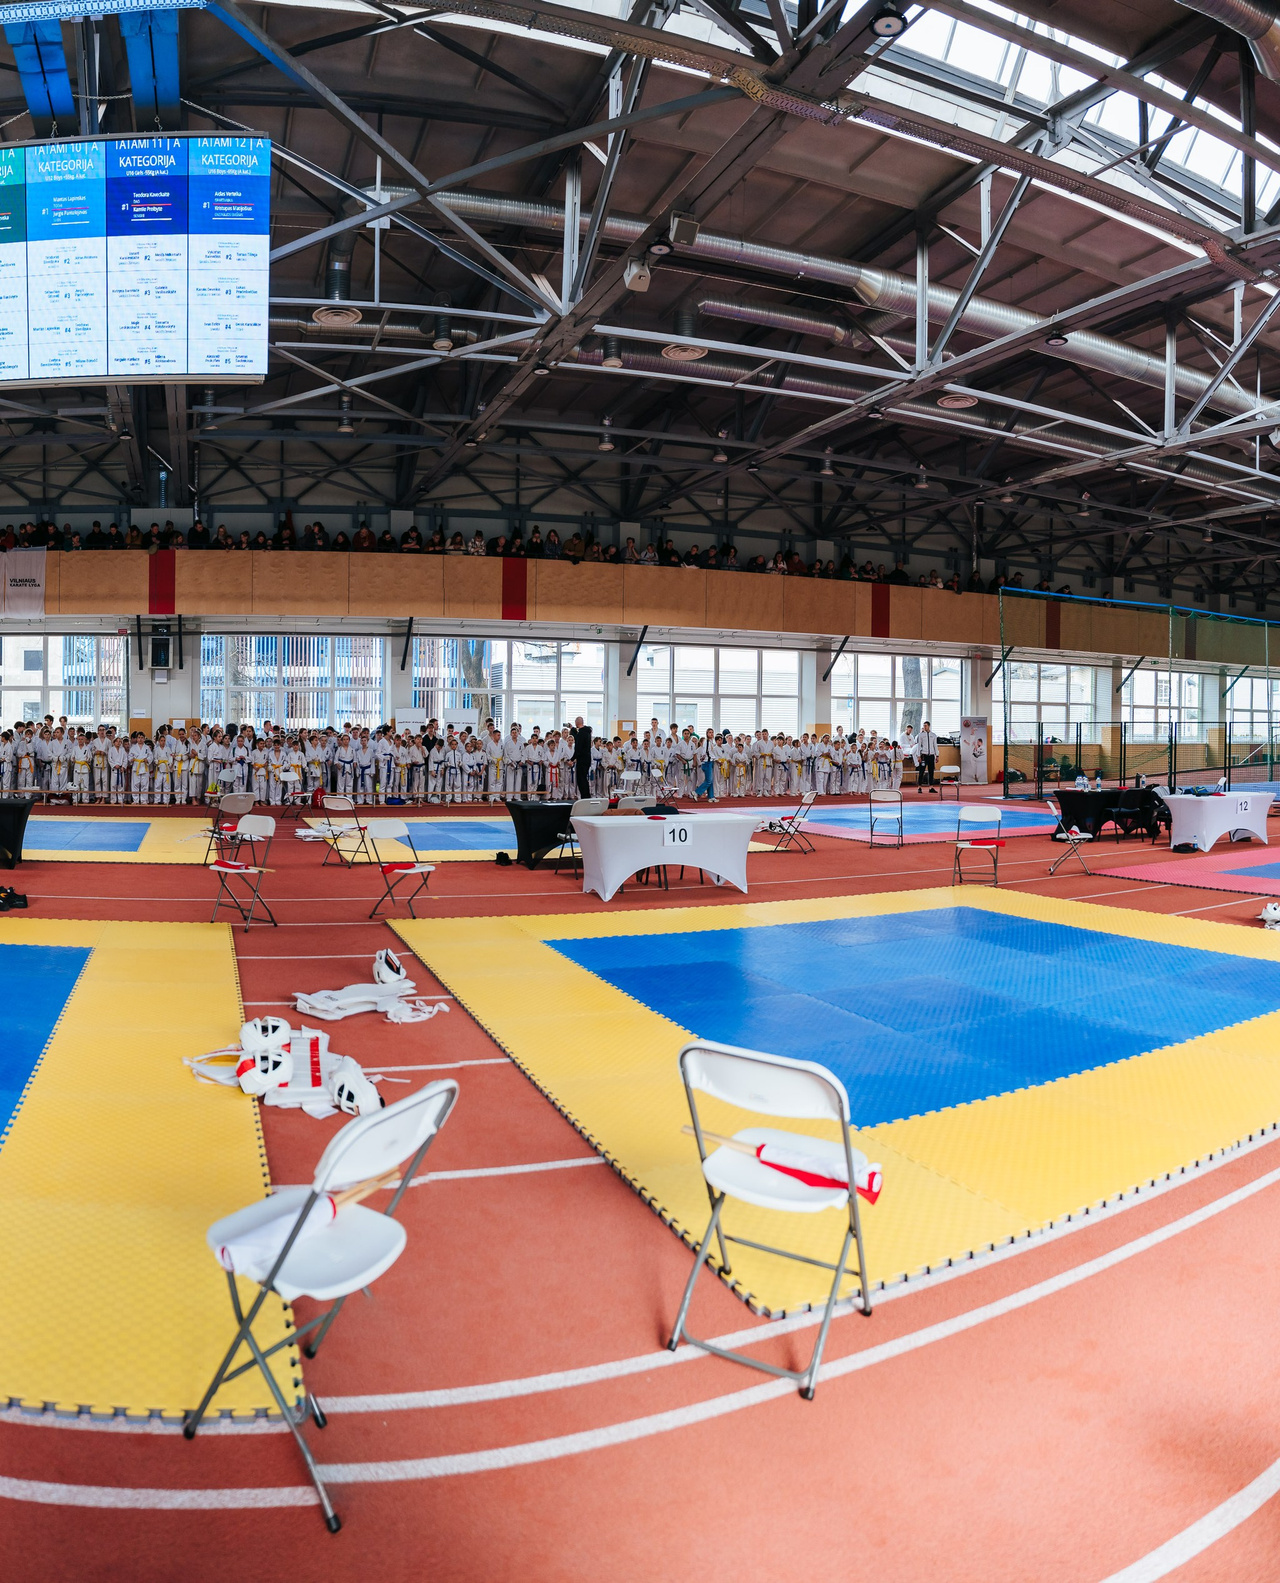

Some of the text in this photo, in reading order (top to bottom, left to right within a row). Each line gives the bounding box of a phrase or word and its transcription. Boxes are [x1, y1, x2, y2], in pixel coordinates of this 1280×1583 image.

[71, 143, 82, 152] 10
[91, 142, 99, 151] A
[152, 138, 162, 148] 11
[173, 138, 181, 148] A
[234, 138, 246, 147] 12
[256, 138, 264, 148] A
[8, 148, 15, 158] A
[38, 158, 94, 173] KATEGORIJA
[119, 155, 176, 168] KATEGORIJA
[202, 154, 259, 168] KATEGORIJA
[202, 201, 210, 209] #1
[1239, 800, 1248, 811] 12
[668, 828, 688, 843] 10
